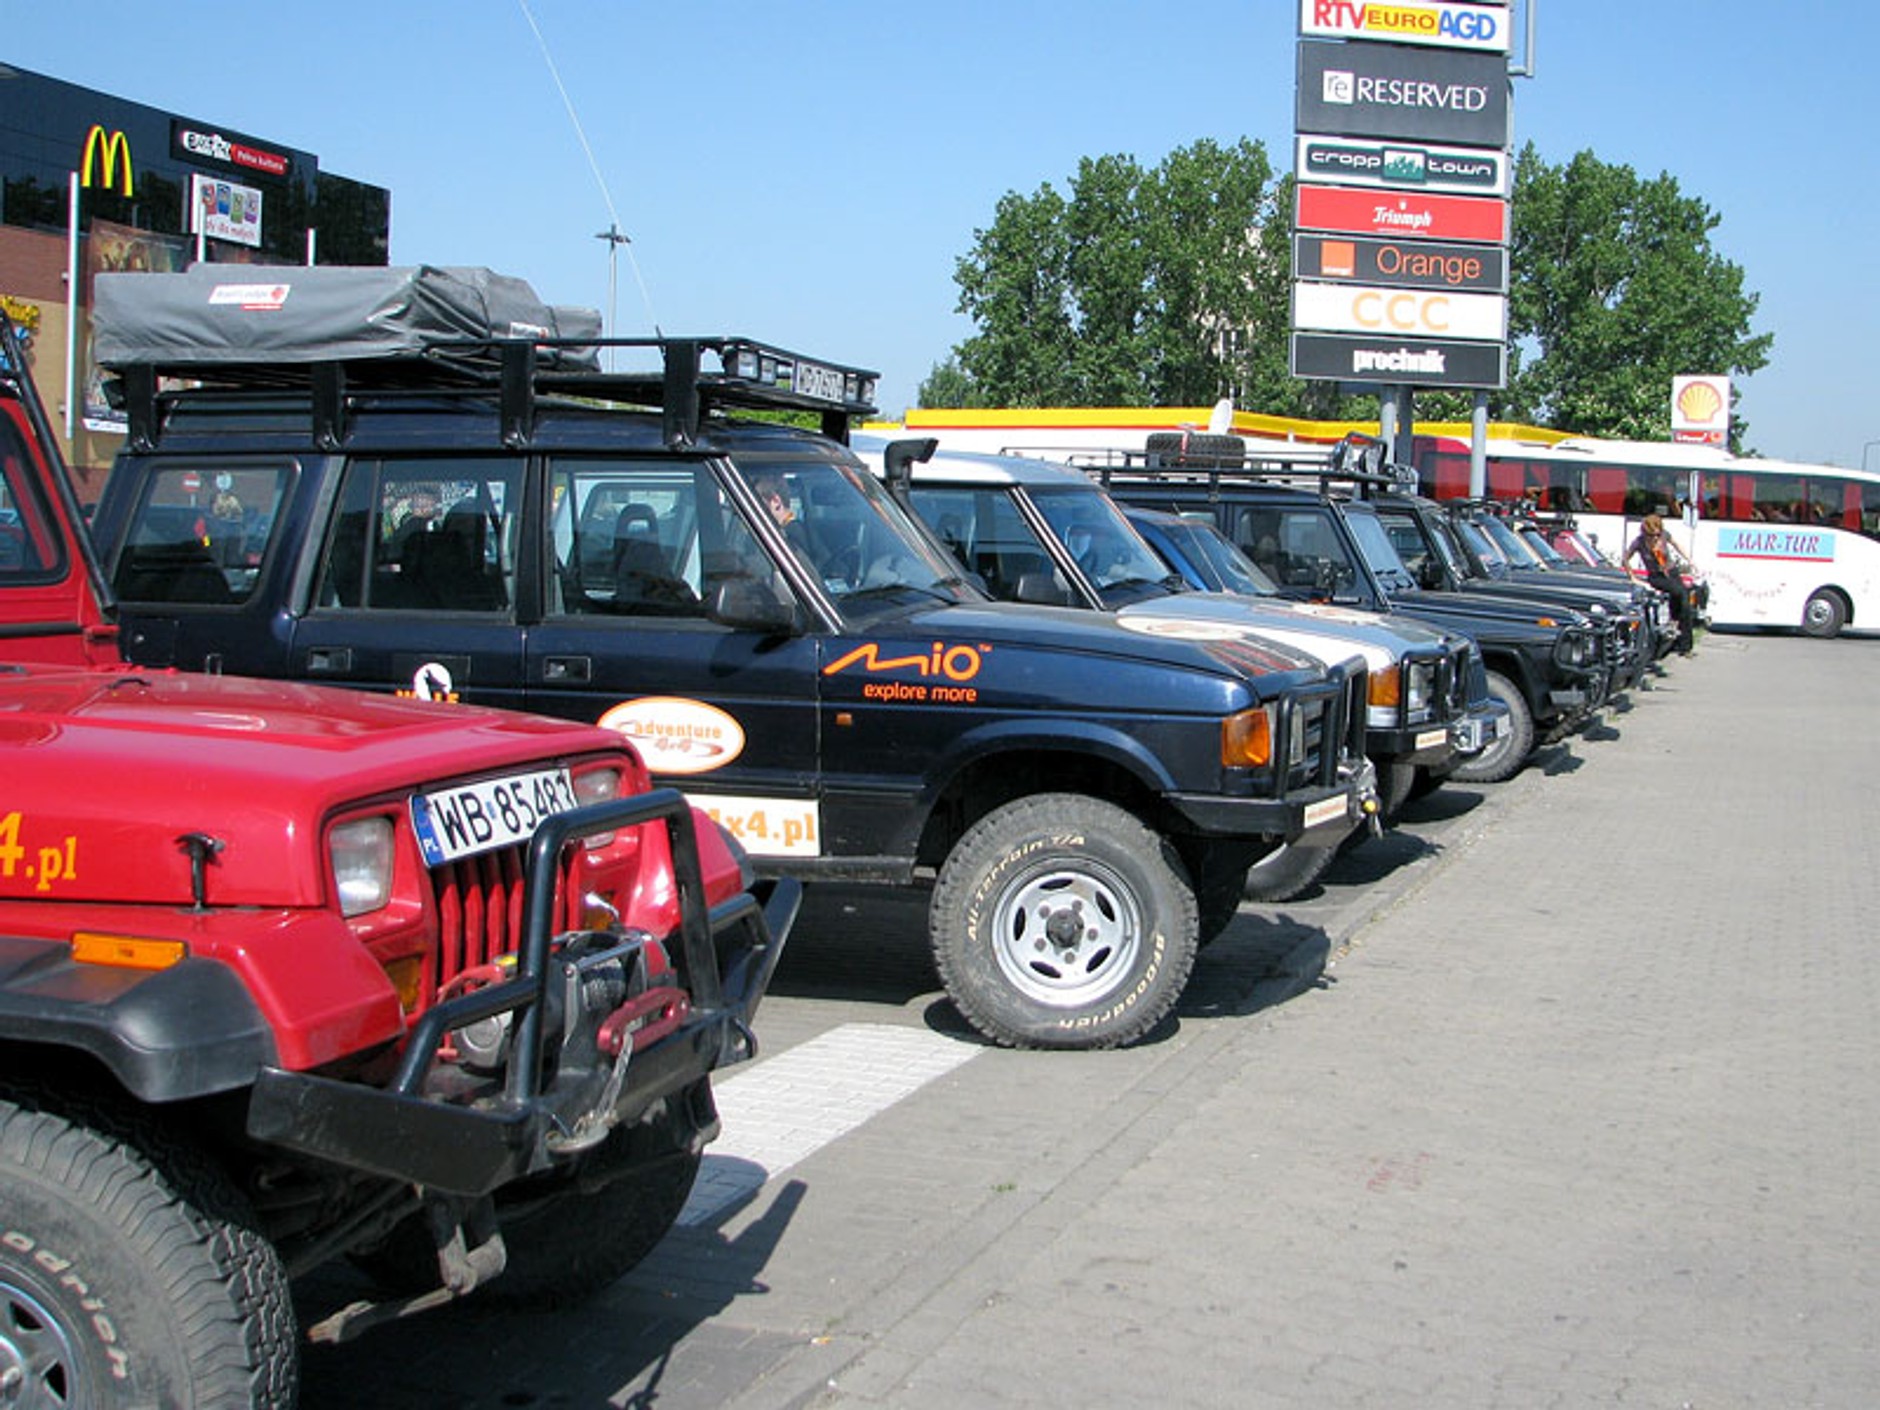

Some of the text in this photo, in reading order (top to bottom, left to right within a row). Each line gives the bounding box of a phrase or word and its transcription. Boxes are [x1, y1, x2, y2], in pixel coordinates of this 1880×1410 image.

[1313, 0, 1496, 39] RTV EURO AGD
[1357, 78, 1486, 111] RESERVED
[1311, 152, 1491, 176] cropp town
[1373, 206, 1432, 230] Triumph
[1377, 245, 1481, 284] Orange
[1352, 292, 1449, 331] CCC
[1734, 531, 1821, 553] MAR-TUR
[864, 682, 977, 702] explore more
[634, 719, 722, 739] adventure
[433, 791, 493, 850] WB
